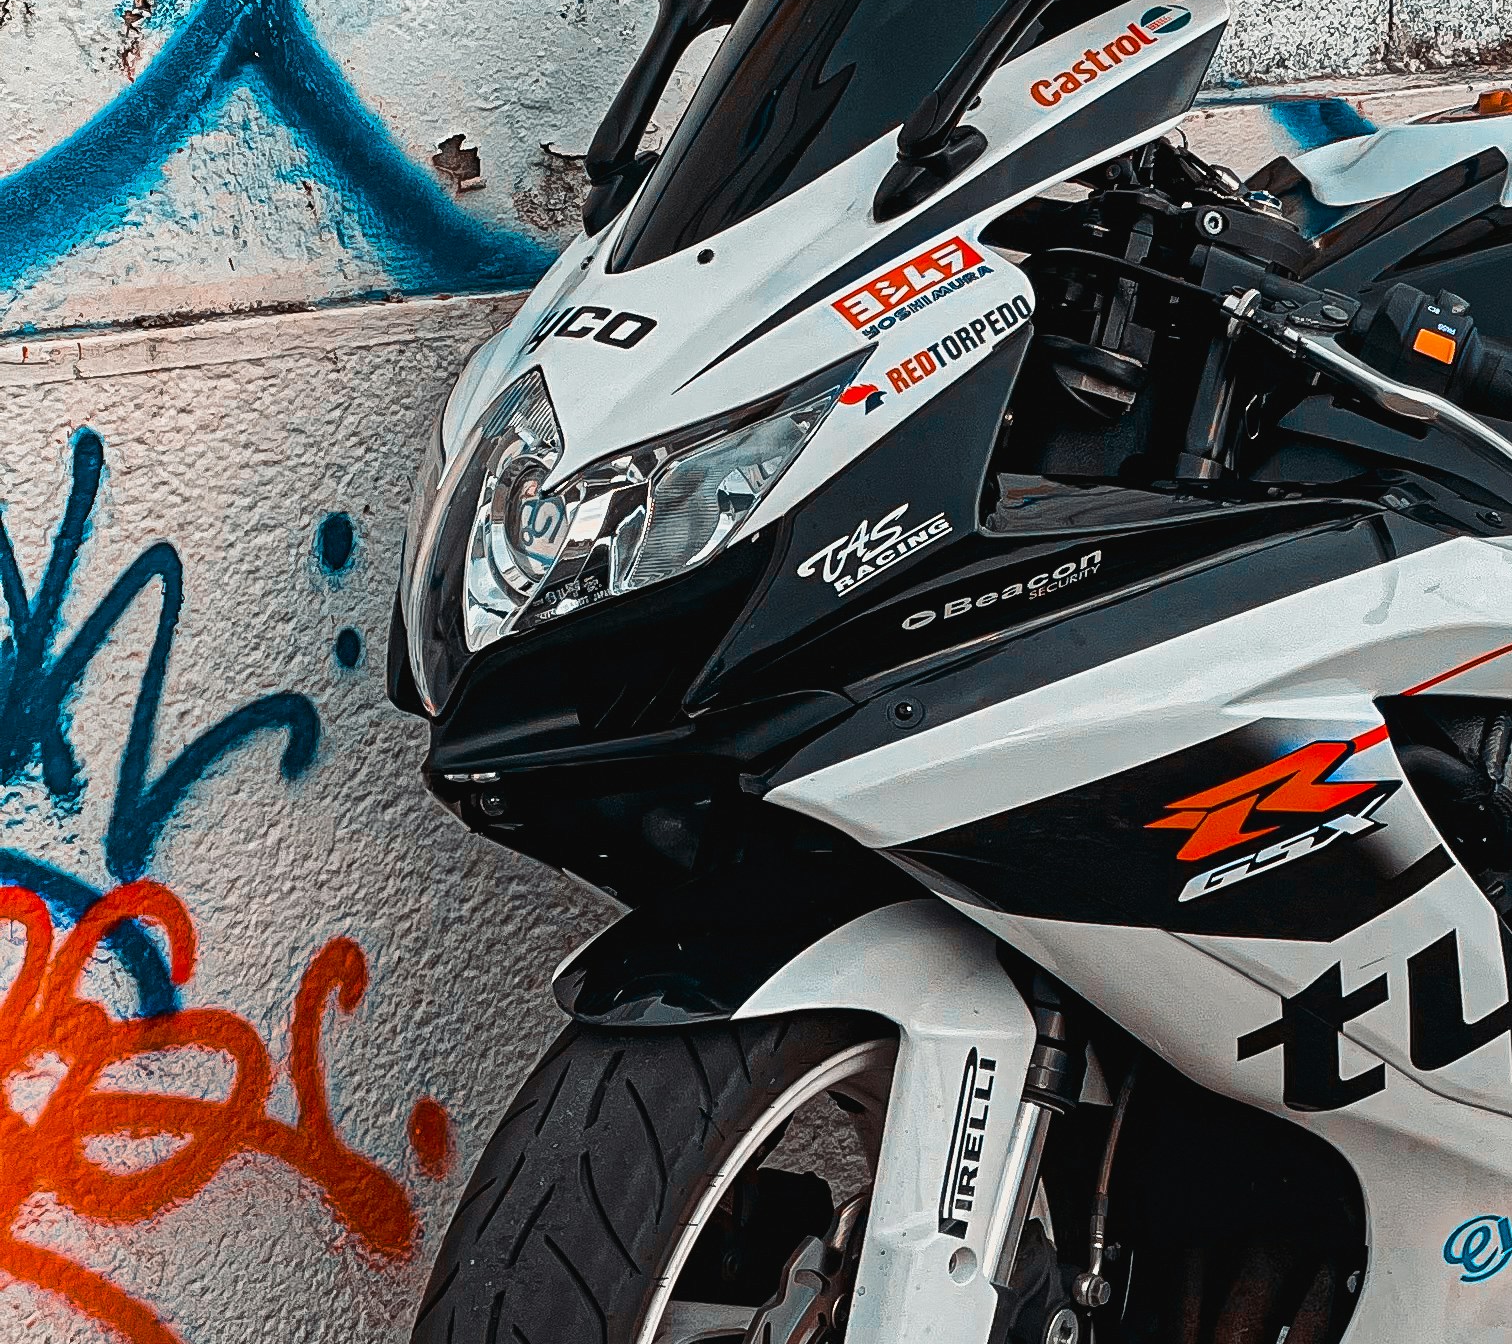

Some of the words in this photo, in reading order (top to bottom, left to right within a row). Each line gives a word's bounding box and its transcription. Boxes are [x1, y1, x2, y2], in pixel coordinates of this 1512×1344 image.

[1030, 22, 1158, 107] Castrol
[526, 305, 658, 355] yco
[861, 264, 995, 340] YOSHIMURA
[885, 294, 1033, 395] REDTORPEDO
[797, 502, 909, 583] TAS
[833, 518, 951, 594] RACING
[943, 549, 1103, 620] Beacon
[1028, 563, 1101, 601] SECURITY
[1177, 793, 1387, 903] GSX
[938, 1046, 997, 1240] PIRELLI
